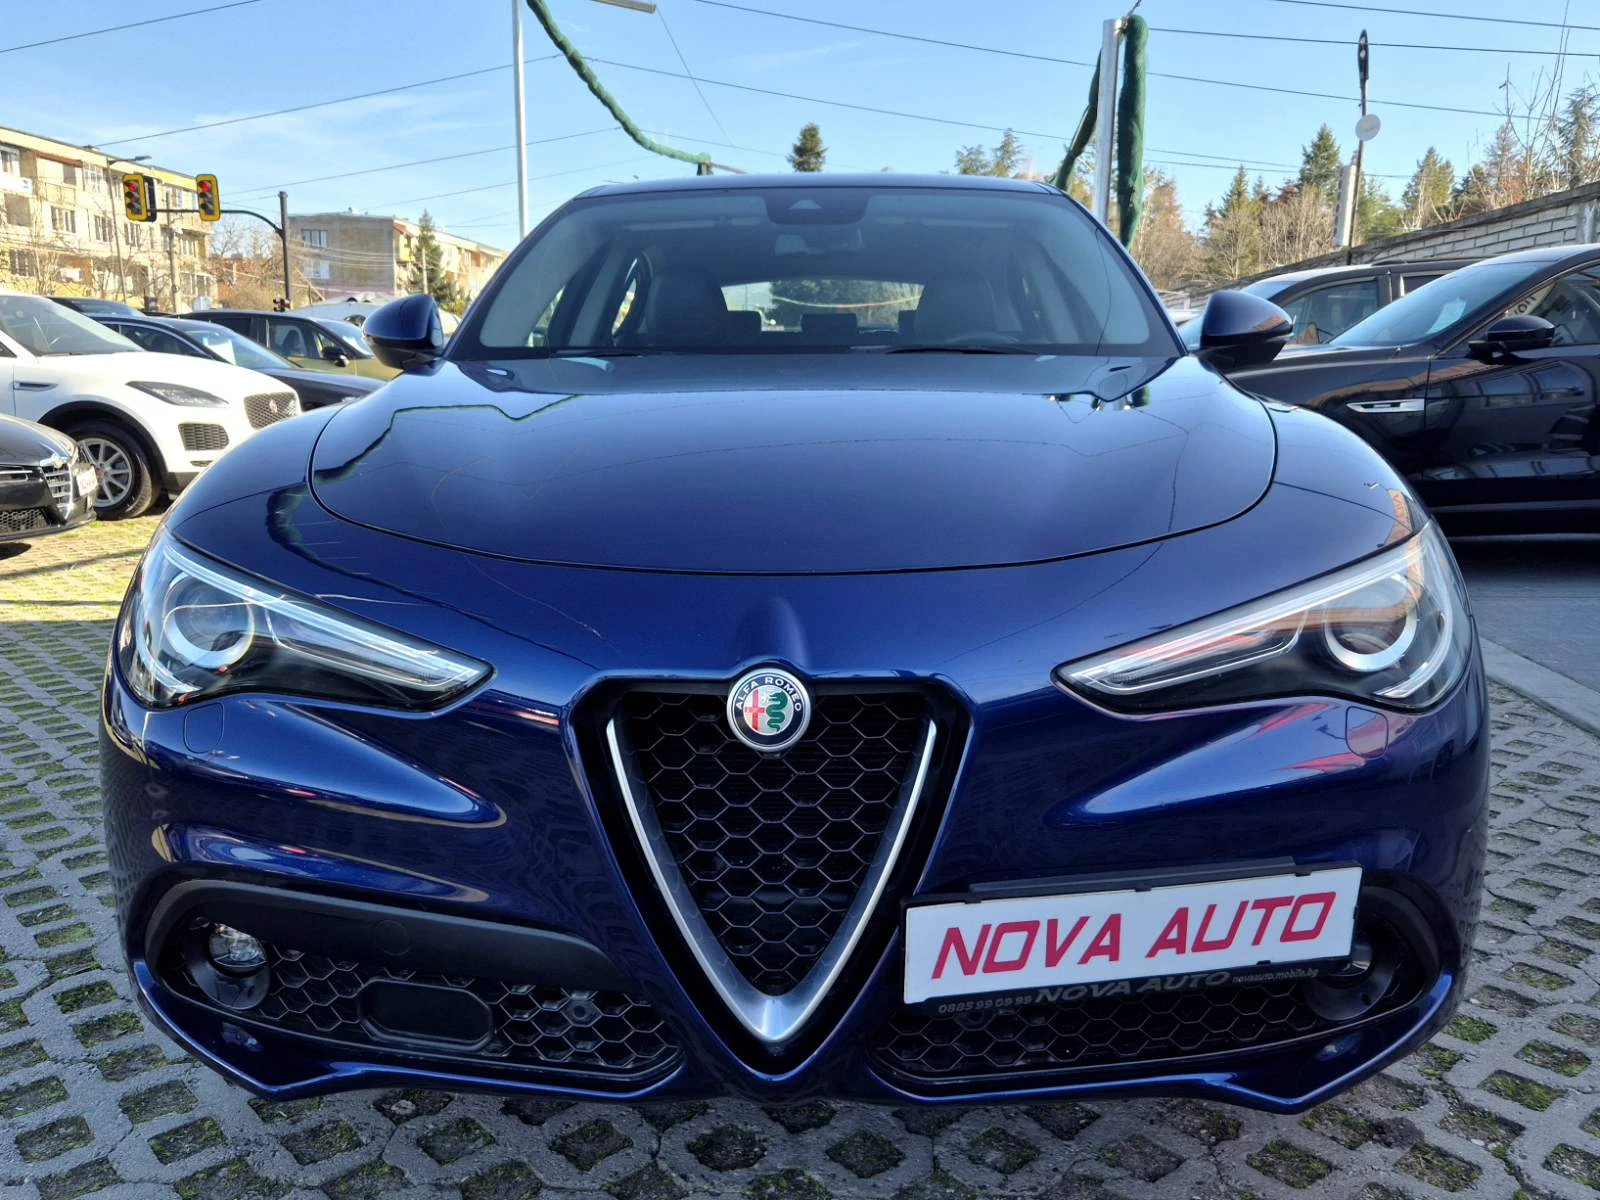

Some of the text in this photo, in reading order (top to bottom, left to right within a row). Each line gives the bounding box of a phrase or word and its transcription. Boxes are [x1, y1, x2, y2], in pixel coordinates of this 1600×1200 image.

[735, 676, 802, 712] ALFA ROMEO
[931, 891, 1337, 980] NOVA AUTO
[938, 1001, 974, 1014] 0885
[1035, 980, 1131, 1003] NOVA
[1137, 971, 1231, 993] AUTO
